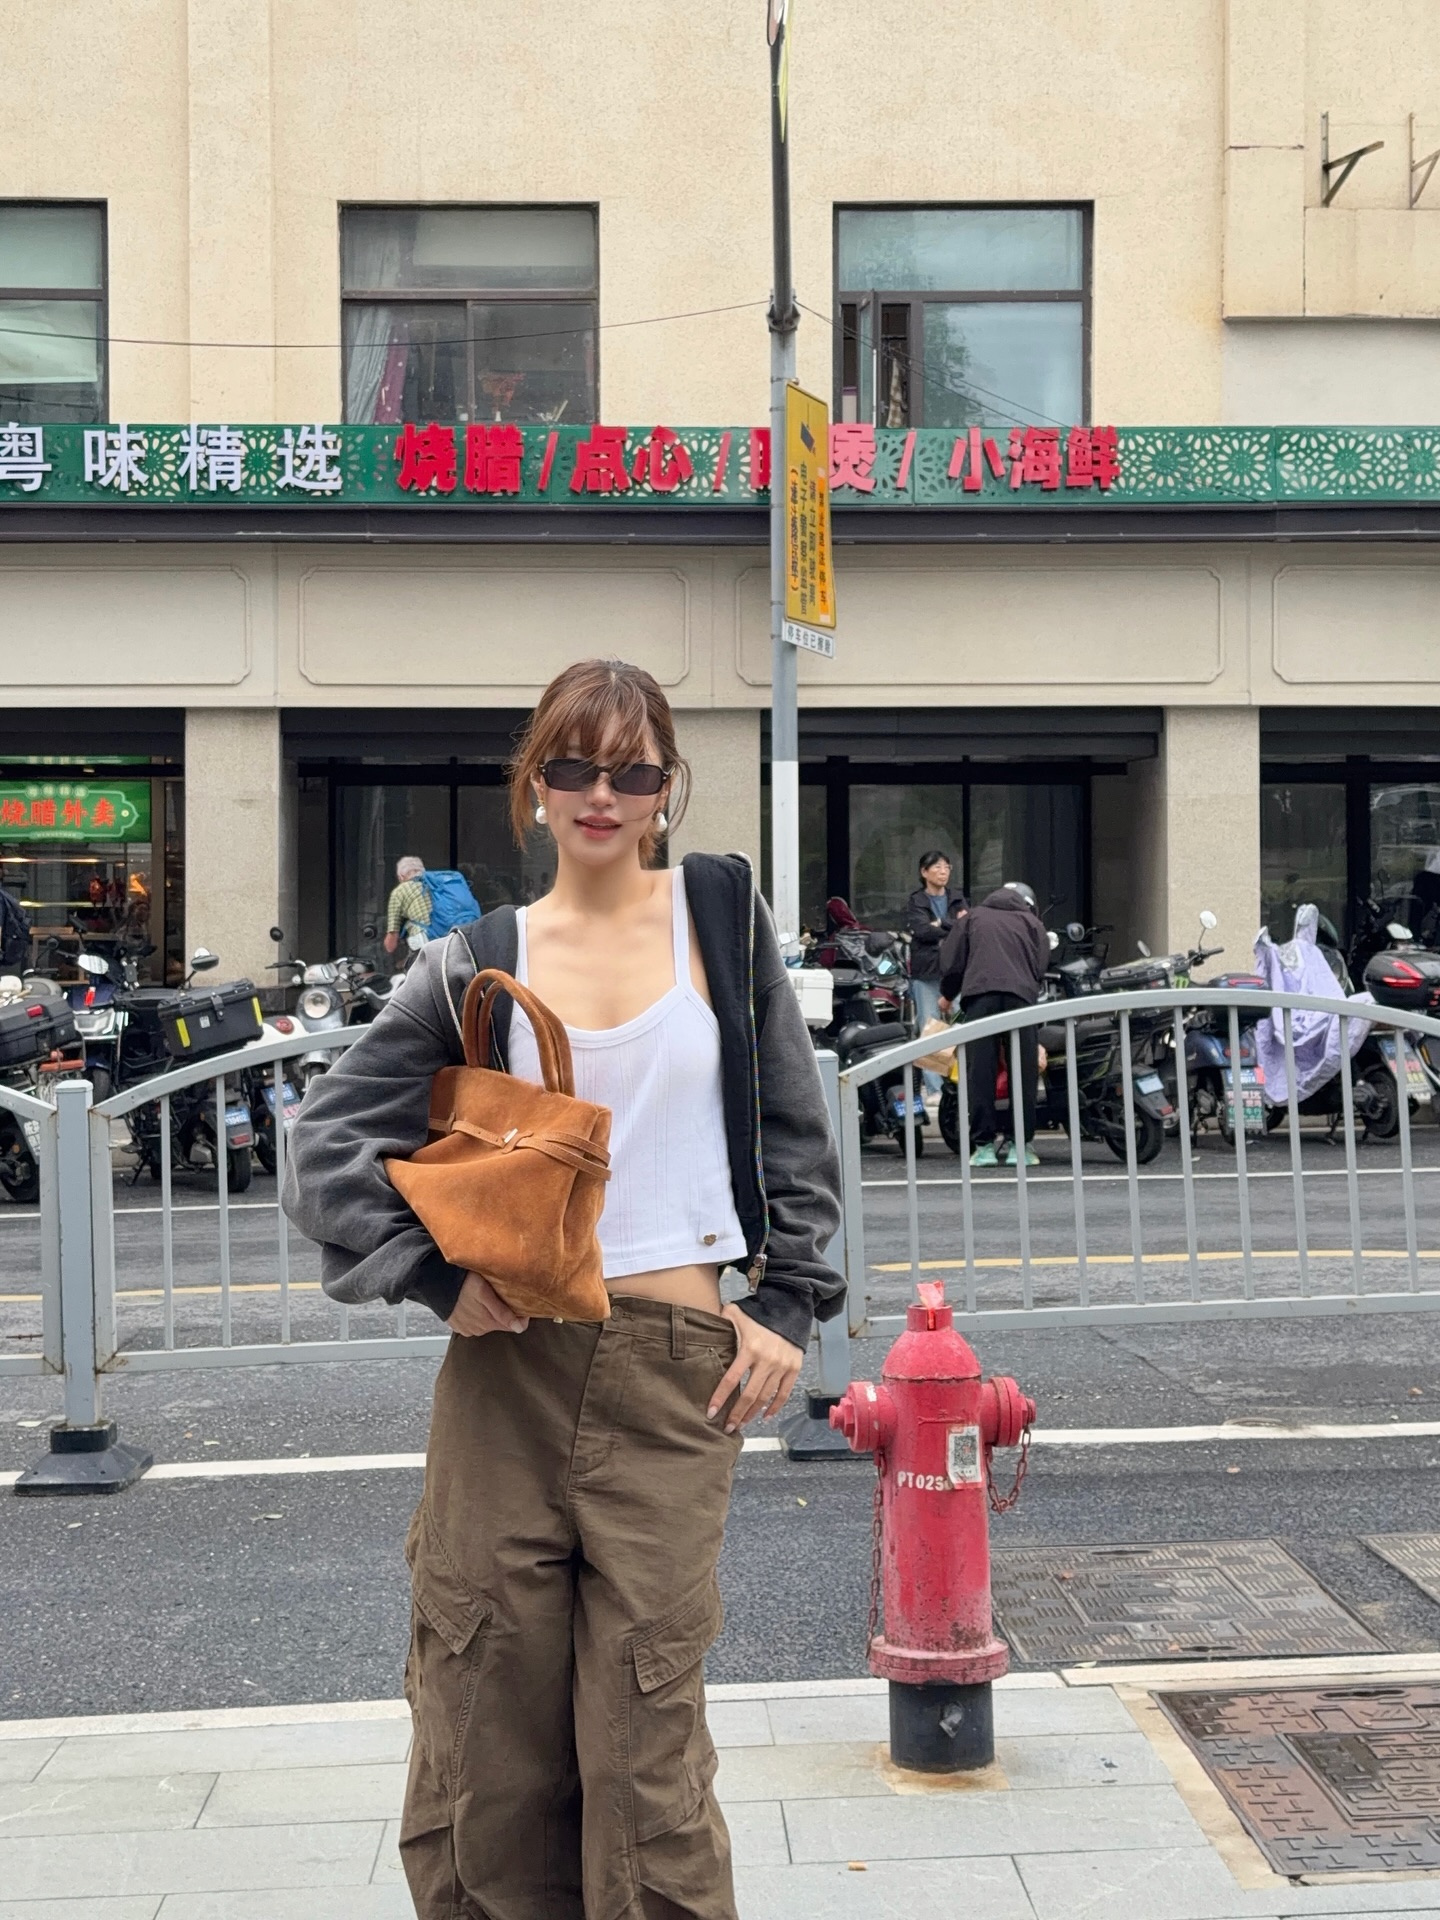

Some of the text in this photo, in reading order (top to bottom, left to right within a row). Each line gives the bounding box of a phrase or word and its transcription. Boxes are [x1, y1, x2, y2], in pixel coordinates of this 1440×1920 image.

[0, 422, 342, 493] 粤味精选
[0, 797, 116, 829] 烧腊外卖
